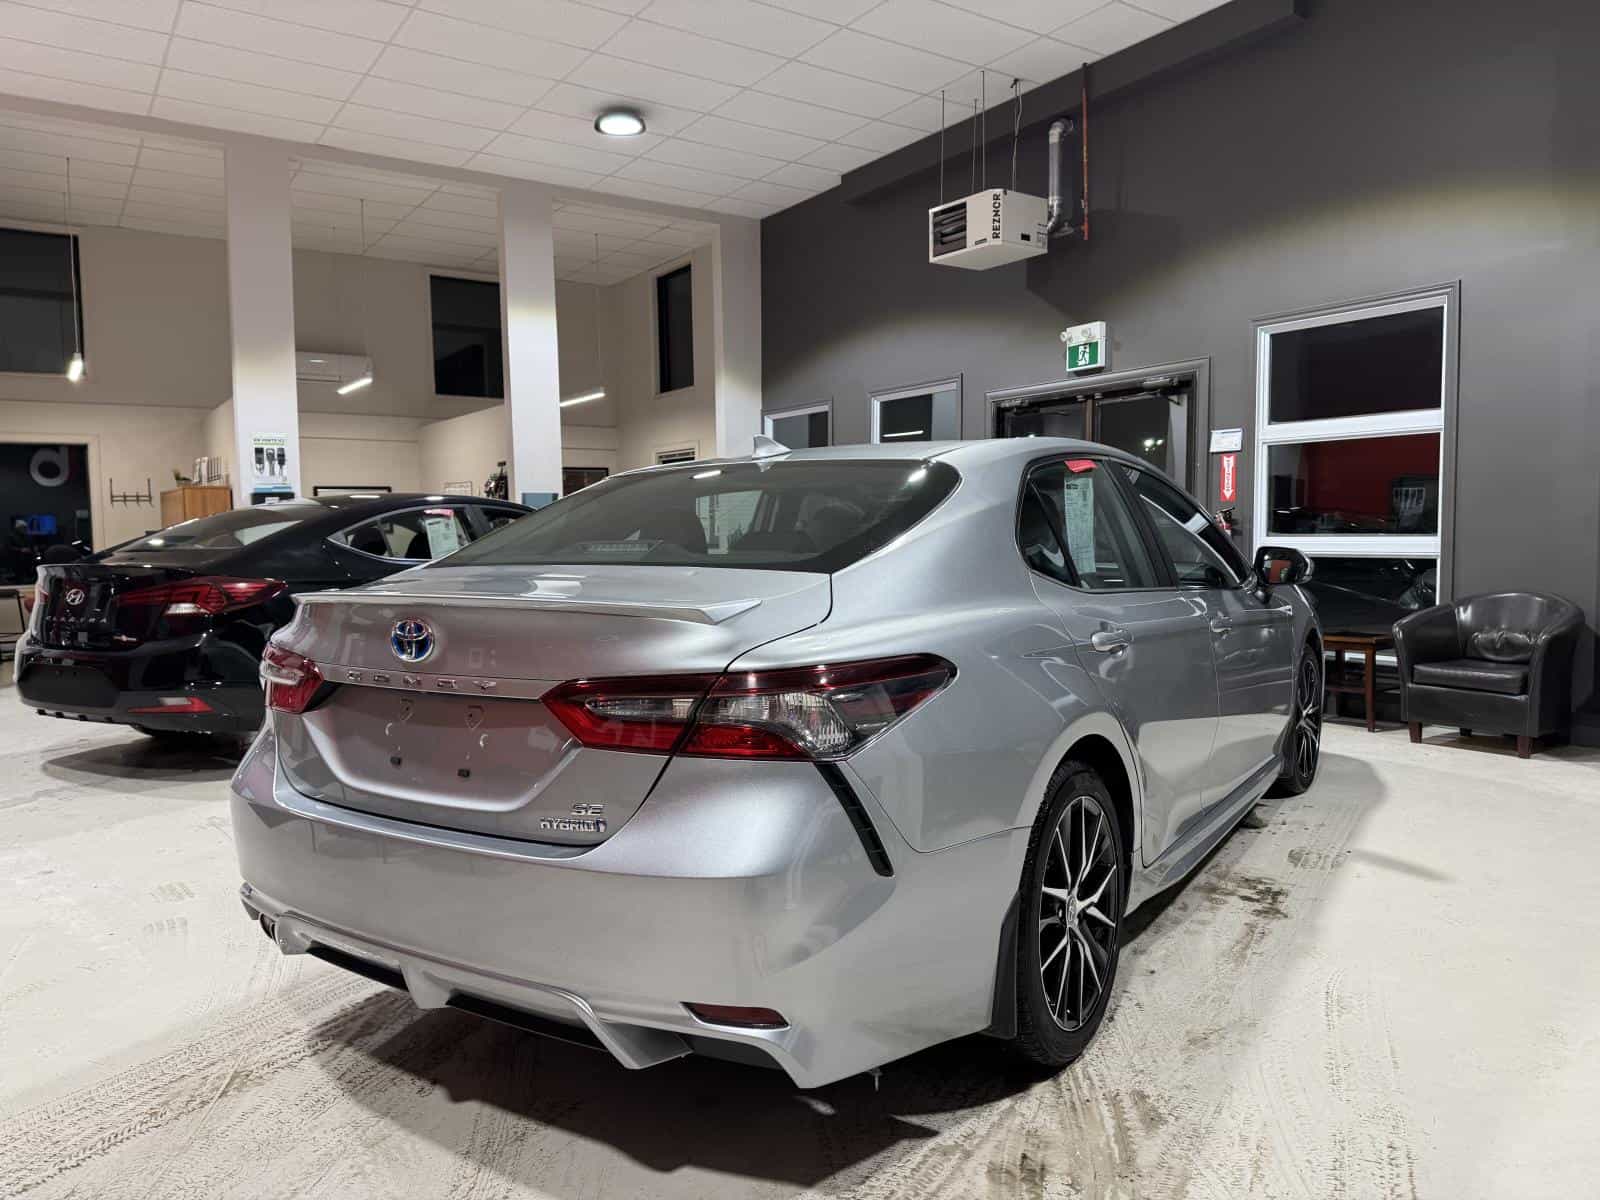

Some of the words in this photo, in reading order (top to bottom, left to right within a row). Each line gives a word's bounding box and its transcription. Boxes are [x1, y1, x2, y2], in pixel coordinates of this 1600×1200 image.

[992, 193, 1001, 239] REZNOR
[571, 803, 604, 816] SE
[540, 816, 595, 832] HYBRID
